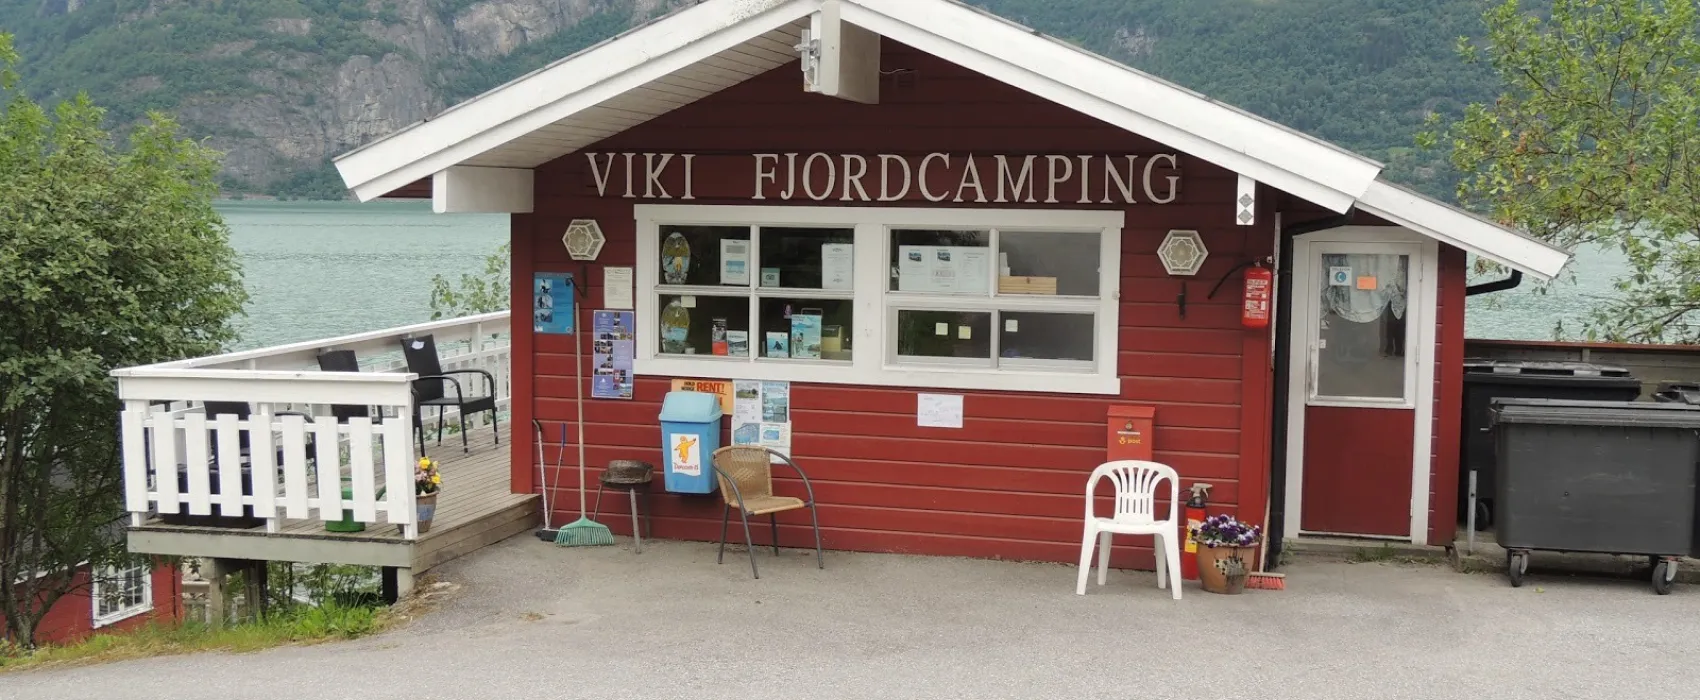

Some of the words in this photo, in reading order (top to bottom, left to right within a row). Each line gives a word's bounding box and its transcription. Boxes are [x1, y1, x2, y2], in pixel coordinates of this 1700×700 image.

[585, 153, 696, 200] VIKI
[752, 152, 1180, 204] FJORDCAMPING
[697, 382, 725, 393] RENT!
